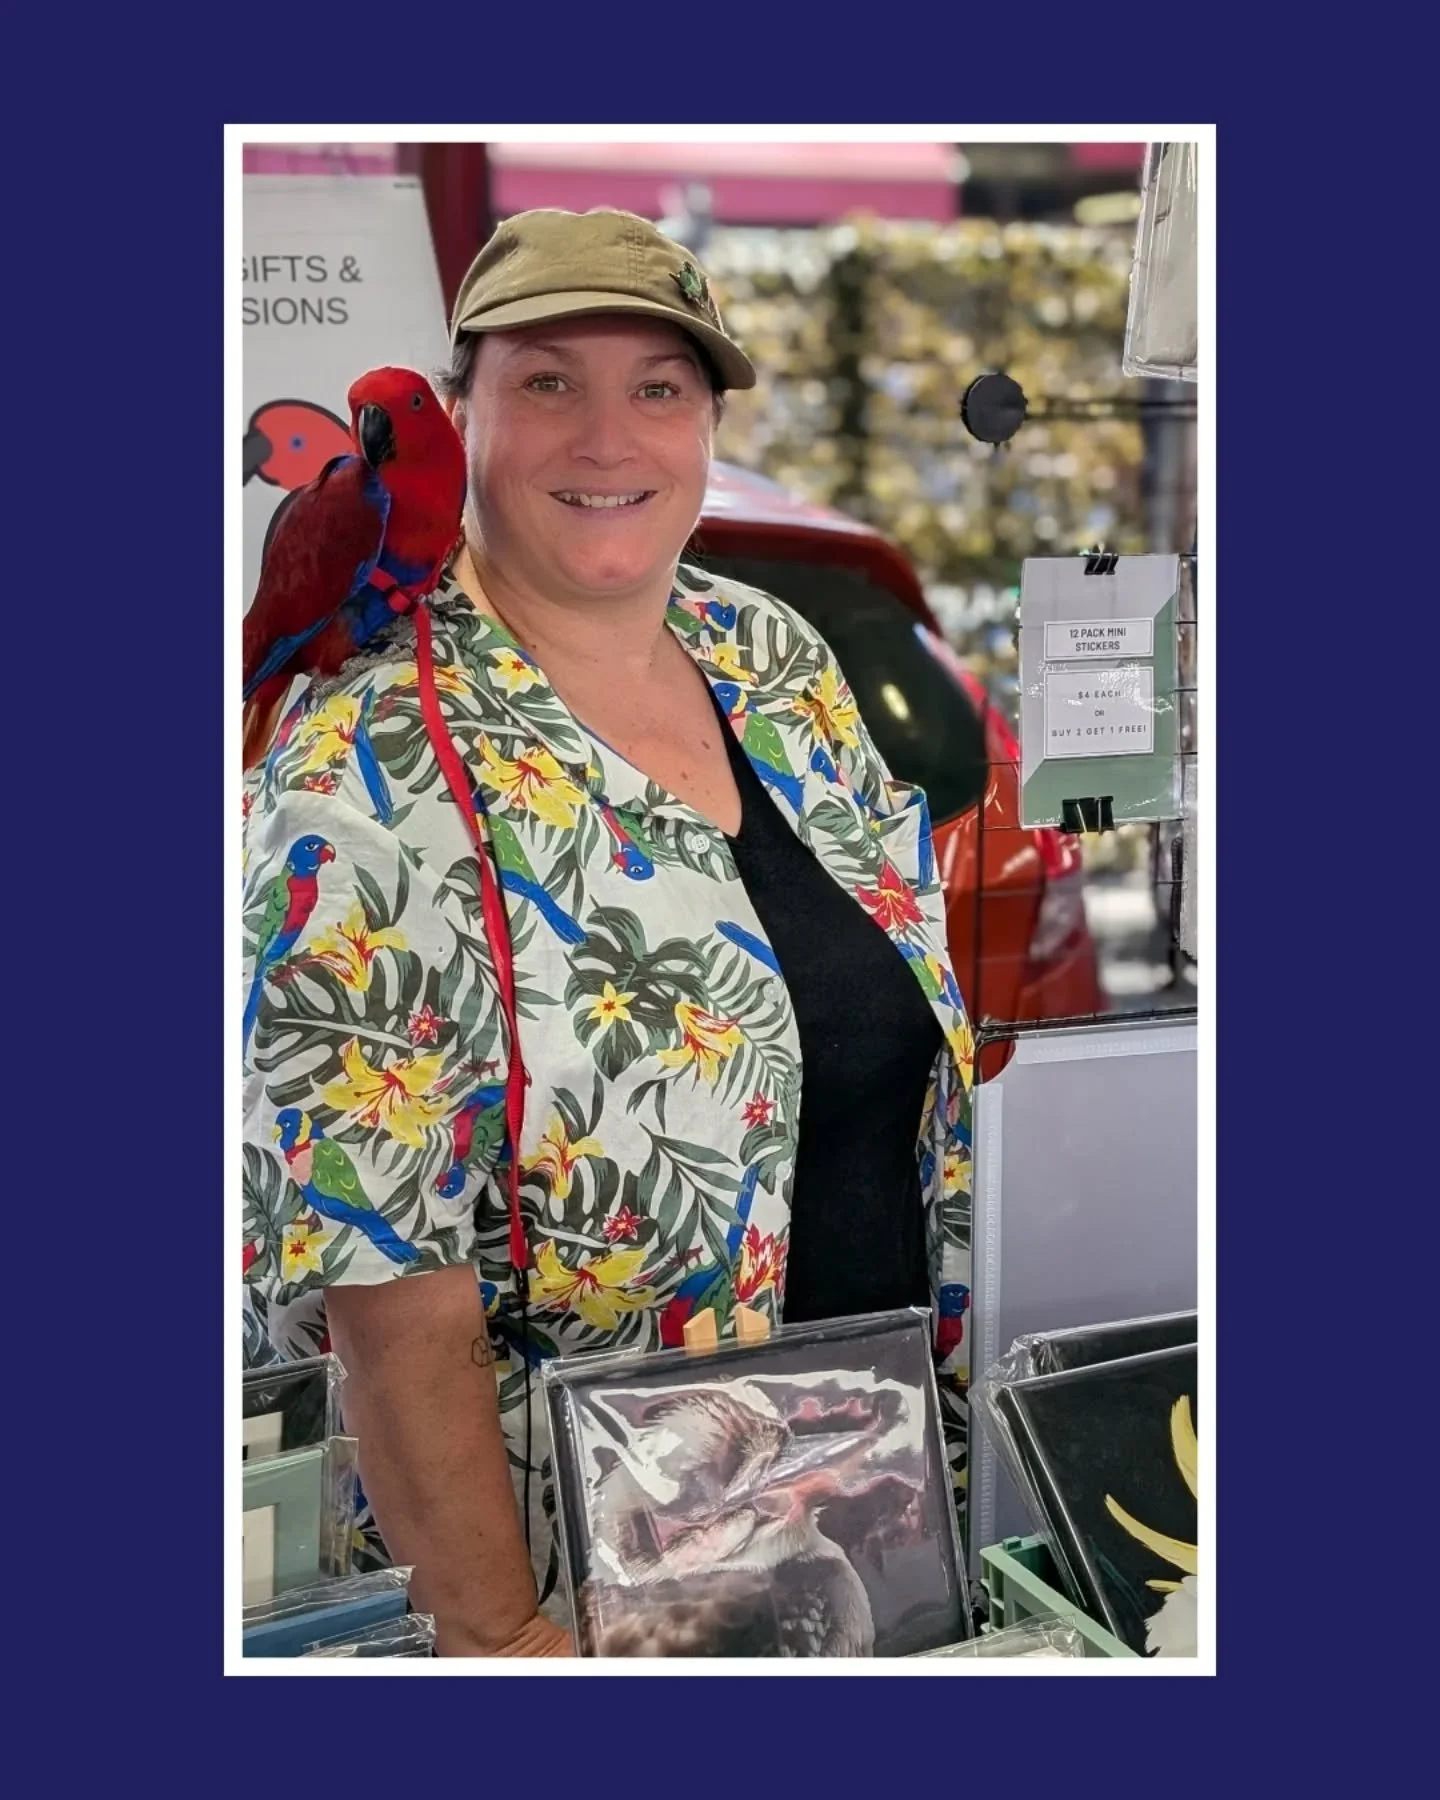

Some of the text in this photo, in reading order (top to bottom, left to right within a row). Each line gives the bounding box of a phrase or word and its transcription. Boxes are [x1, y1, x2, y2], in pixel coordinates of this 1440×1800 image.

[242, 255, 363, 283] IFTS &
[1069, 627, 1127, 638] 12 PACK MINI
[1075, 641, 1121, 652] STICKERS
[1078, 690, 1121, 699] $4 EACH
[1094, 709, 1105, 717] OR
[1051, 728, 1071, 737] BUY
[1076, 728, 1081, 736] 2
[1086, 726, 1105, 736] GET
[1118, 724, 1146, 734] FREE!
